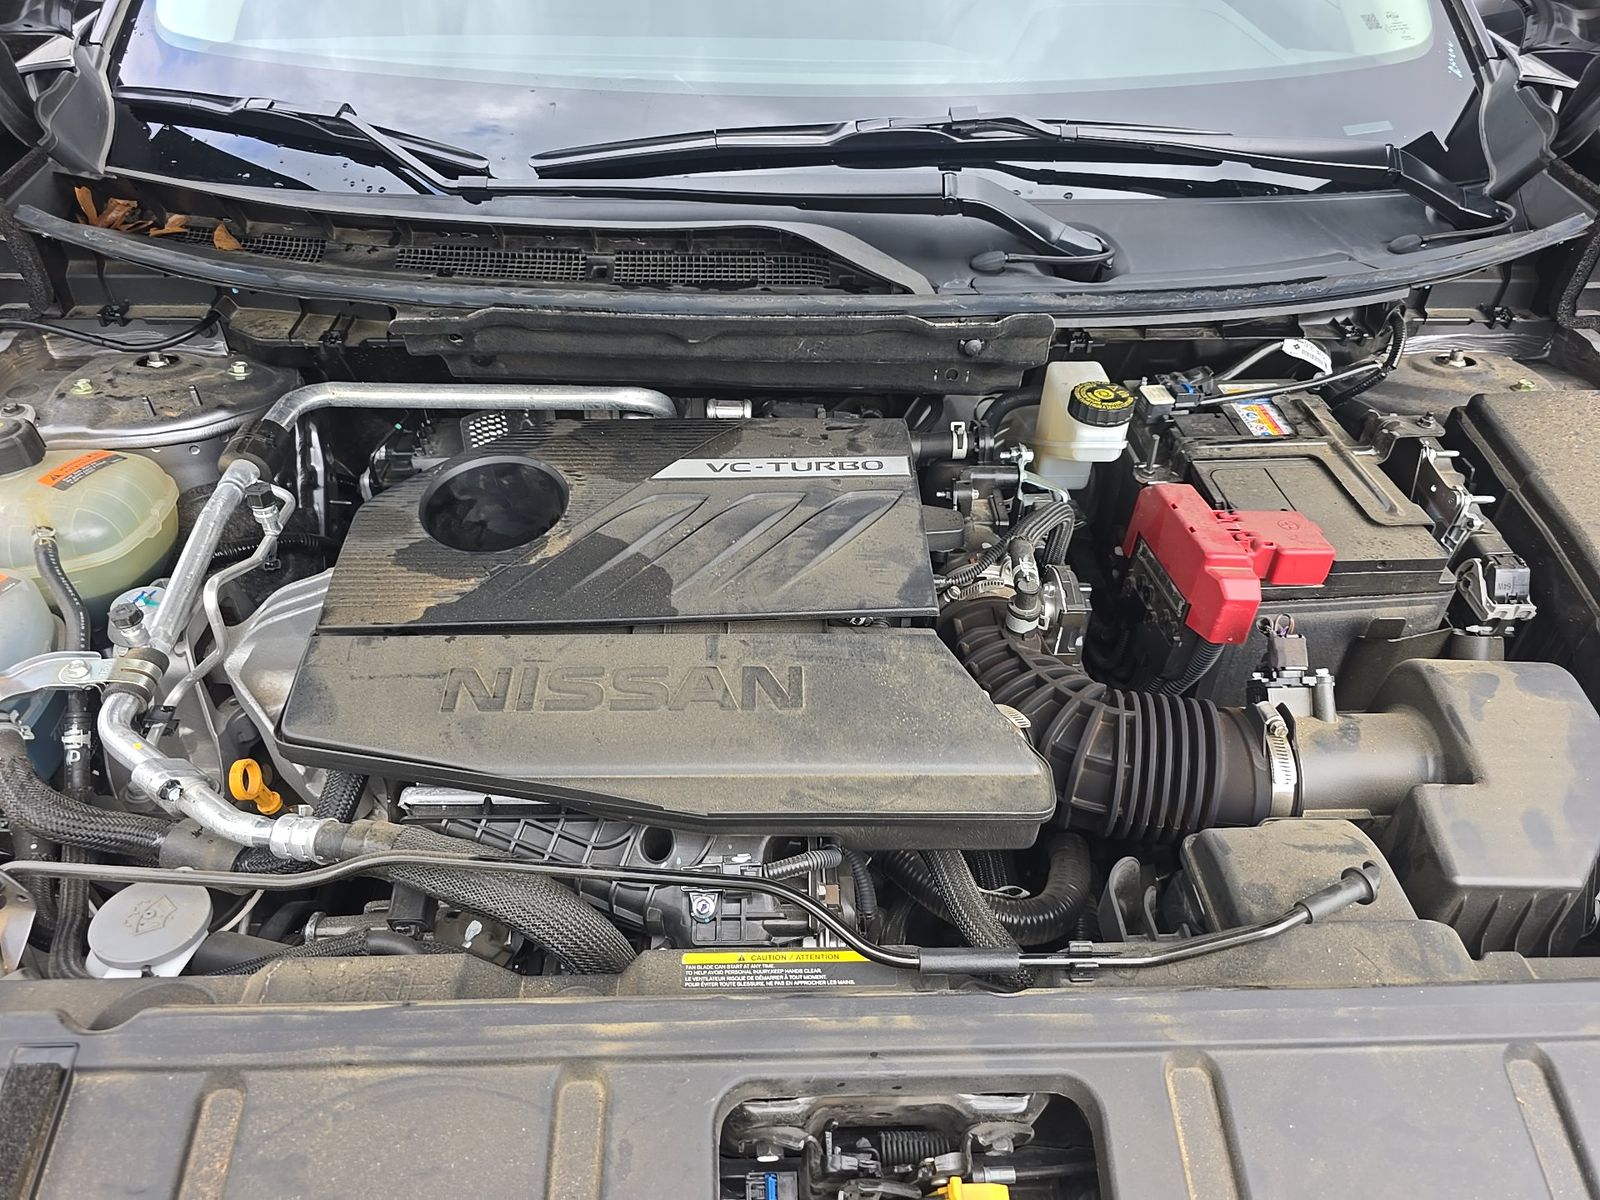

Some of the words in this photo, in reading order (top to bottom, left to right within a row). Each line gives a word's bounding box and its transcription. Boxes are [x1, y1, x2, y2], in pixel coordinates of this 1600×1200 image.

[706, 460, 883, 473] VC-TURBO
[439, 665, 805, 713] NISSAN
[751, 954, 787, 962] CAUTION
[796, 953, 840, 961] ATTENTION
